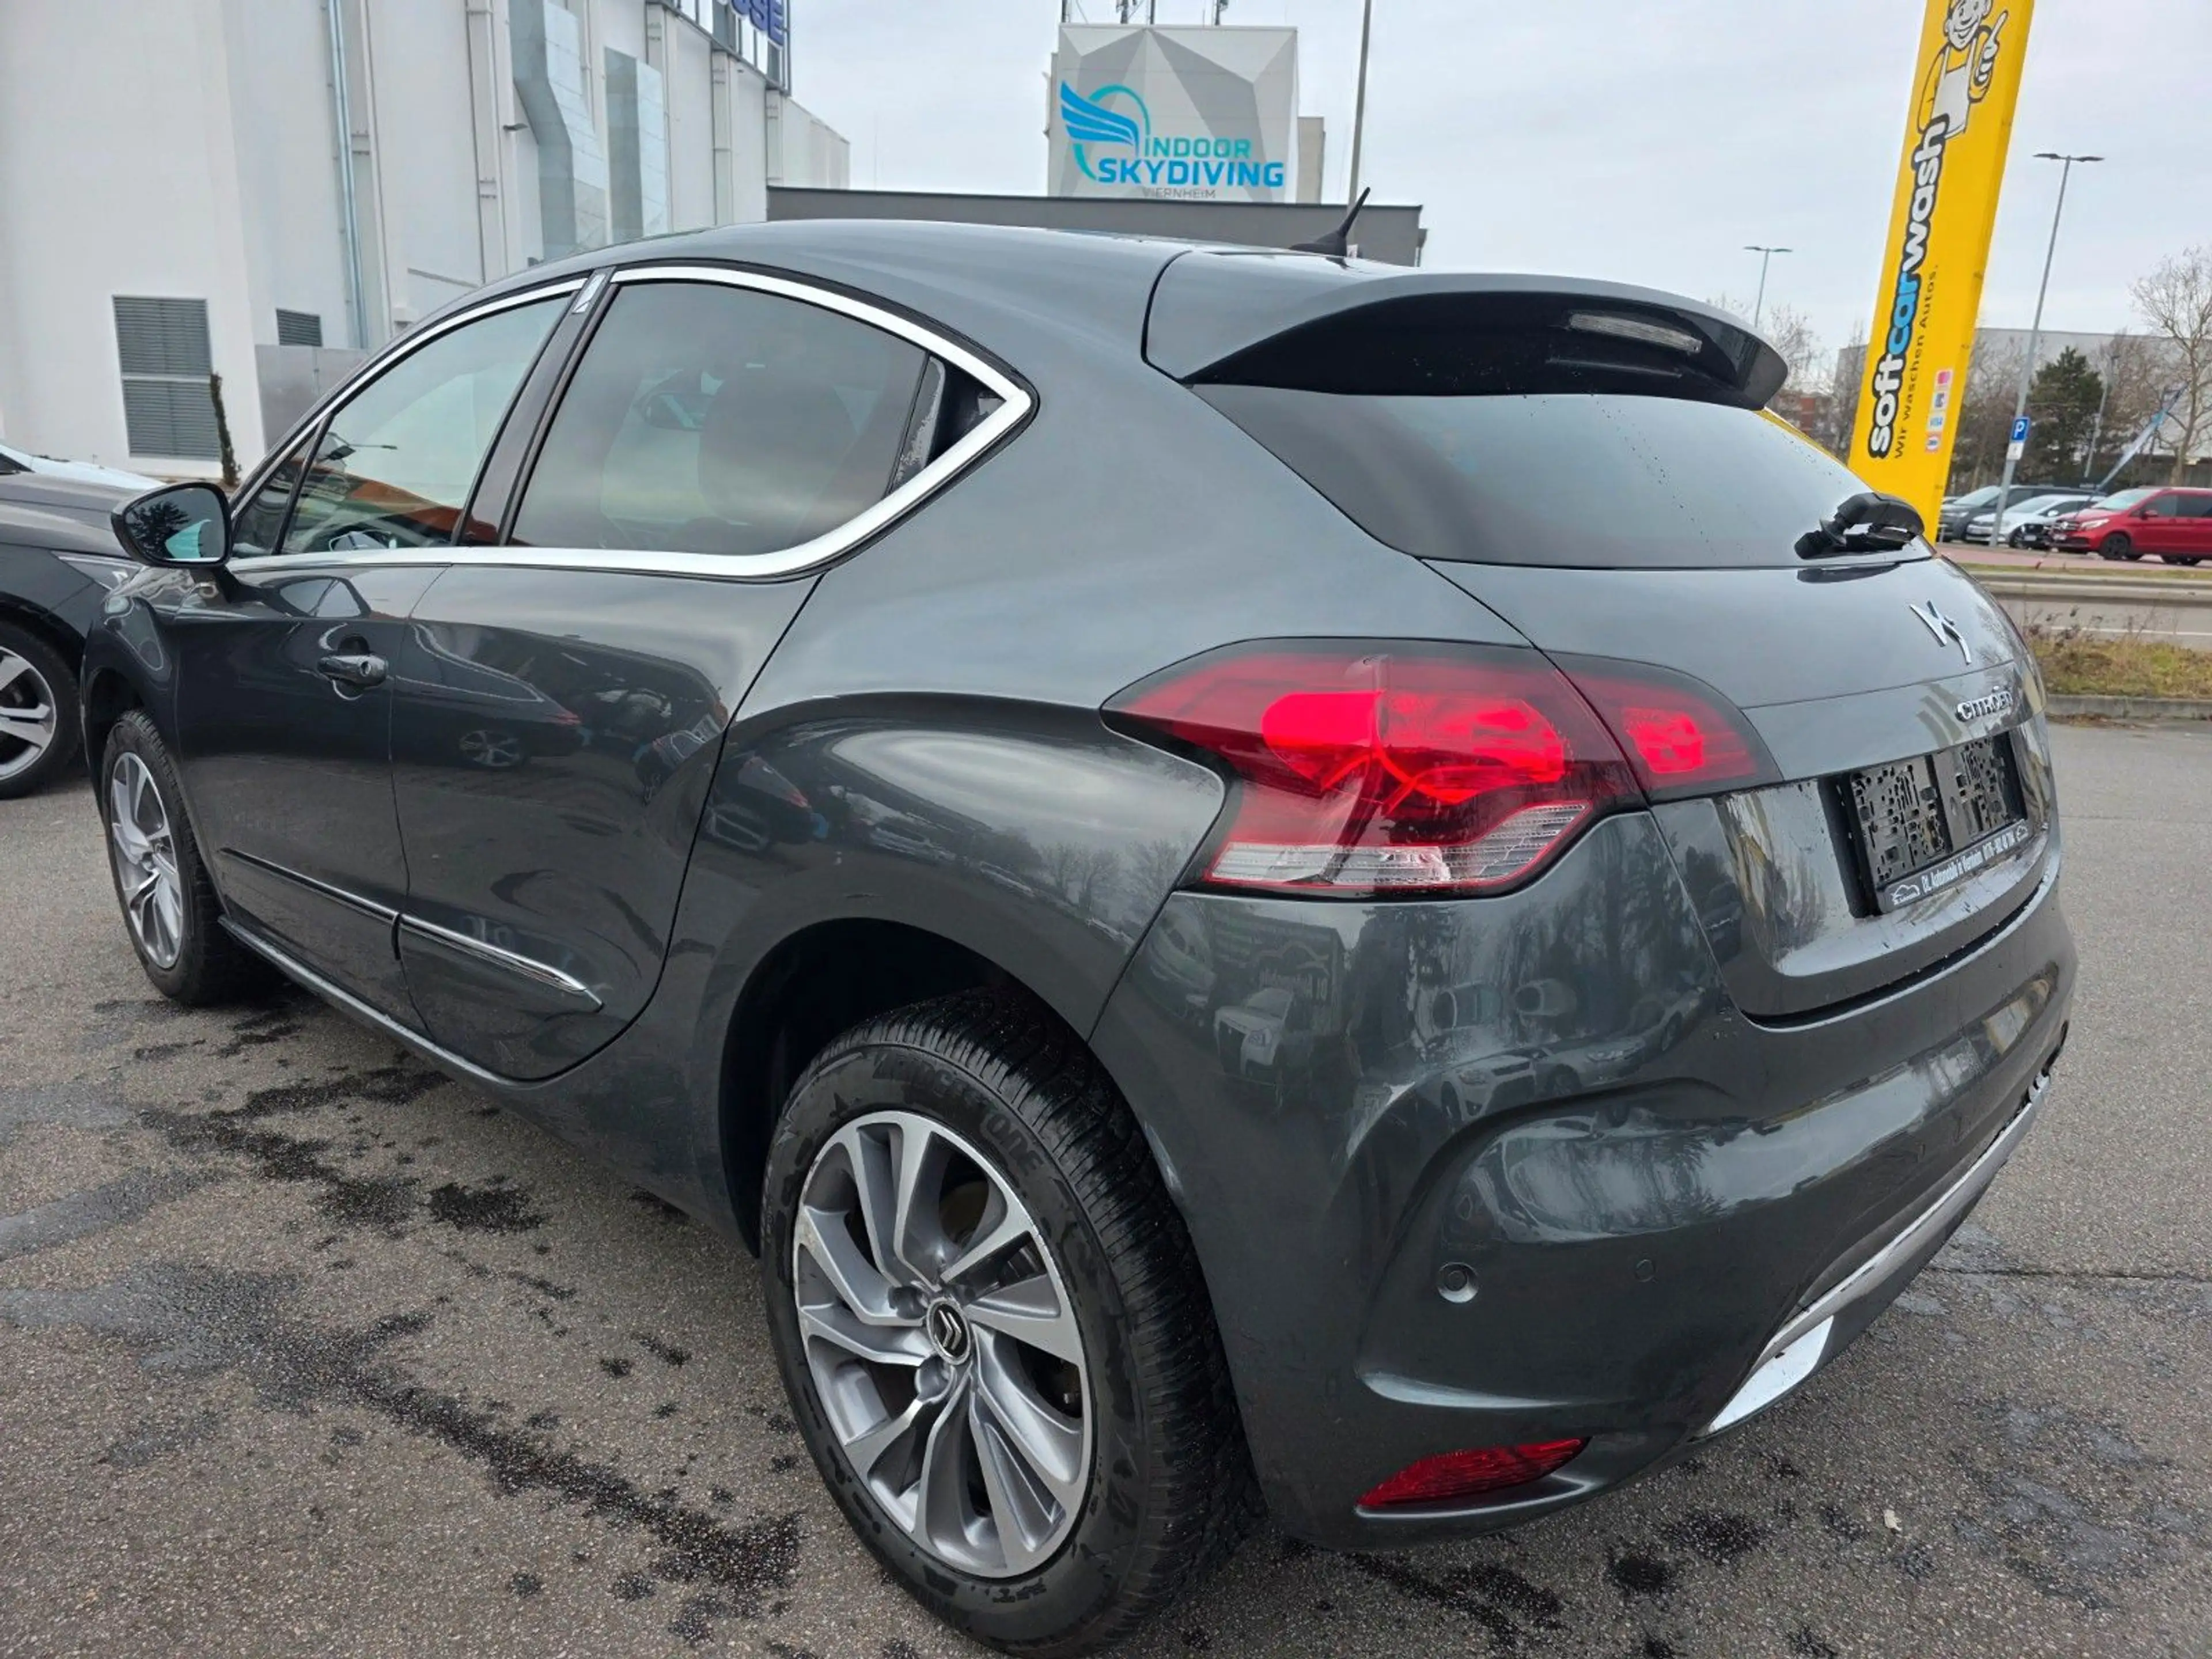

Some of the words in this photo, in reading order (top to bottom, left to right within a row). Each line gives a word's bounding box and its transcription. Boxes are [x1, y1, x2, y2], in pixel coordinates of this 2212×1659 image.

[1145, 137, 1251, 158] INDOOR
[1098, 158, 1285, 187] SKYDIVING
[1870, 117, 1948, 456] softcarwash
[1895, 426, 1908, 459] Wir
[1903, 334, 1925, 421] waschen
[2013, 419, 2025, 438] P
